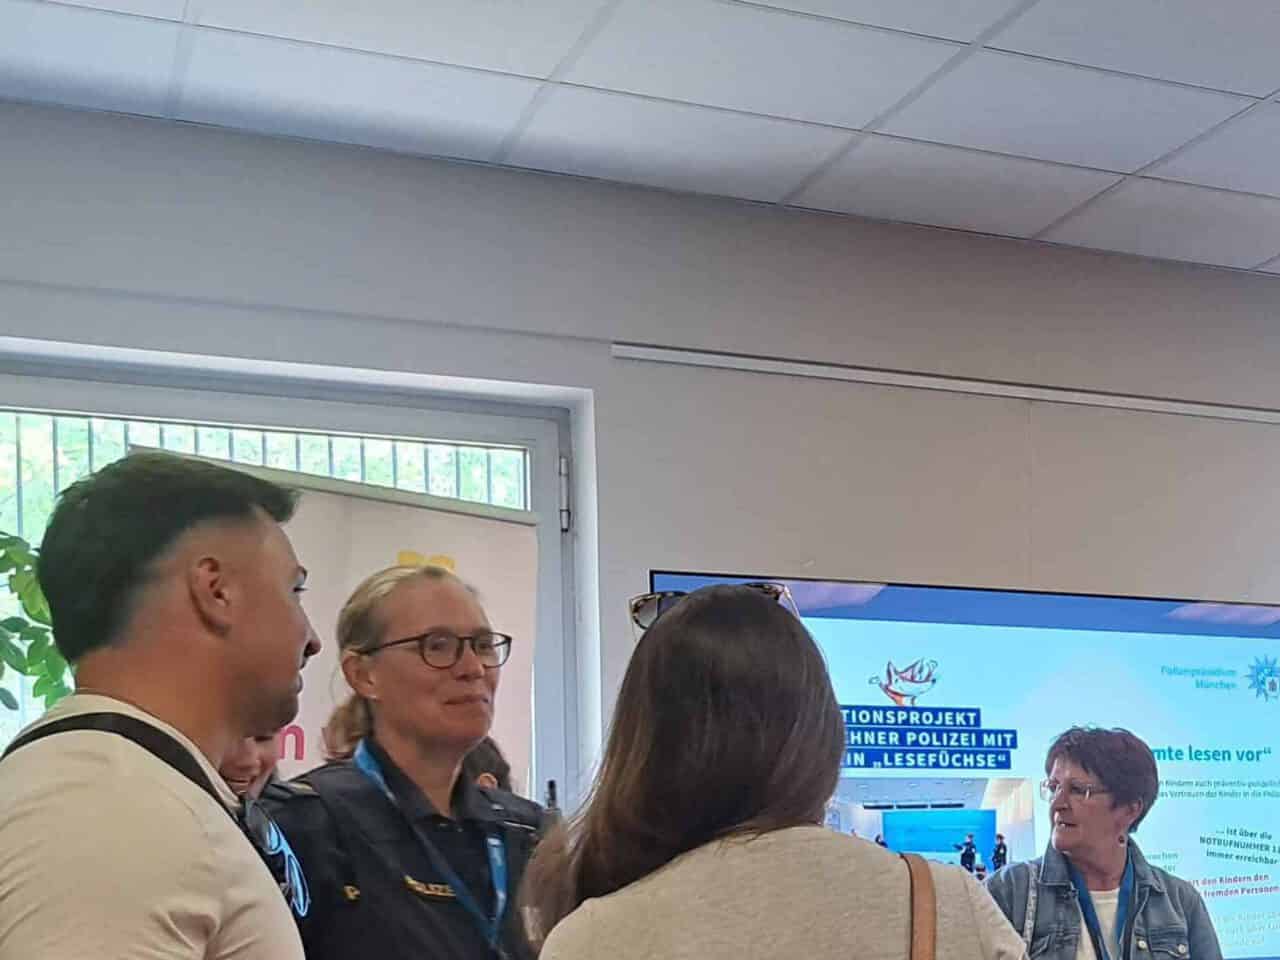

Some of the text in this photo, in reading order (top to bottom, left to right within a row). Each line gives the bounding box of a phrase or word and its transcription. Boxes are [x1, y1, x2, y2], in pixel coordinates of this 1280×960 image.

[846, 731, 1014, 747] HNER POLIZEI MIT
[1188, 743, 1232, 761] lesen
